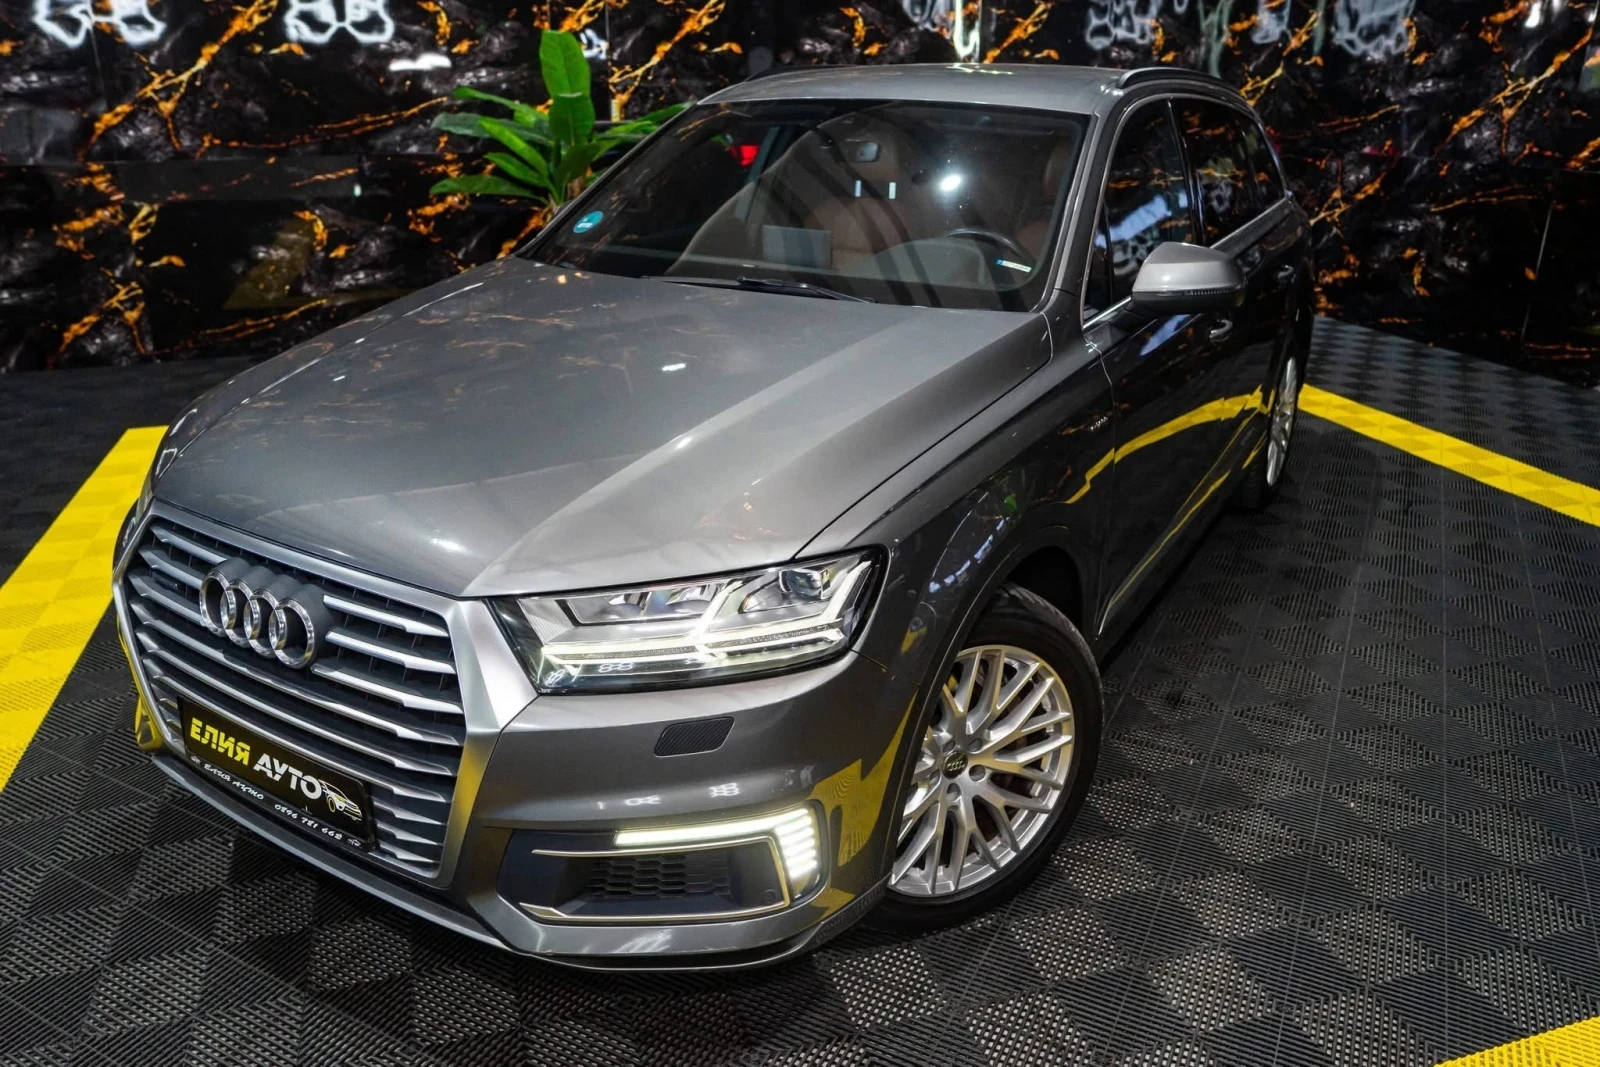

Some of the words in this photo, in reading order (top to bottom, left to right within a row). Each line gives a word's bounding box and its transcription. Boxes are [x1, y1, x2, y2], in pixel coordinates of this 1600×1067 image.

[190, 717, 251, 766] ЕЛИЯ
[253, 753, 322, 799] АУТО
[274, 804, 298, 819] 0896
[321, 827, 343, 840] 668
